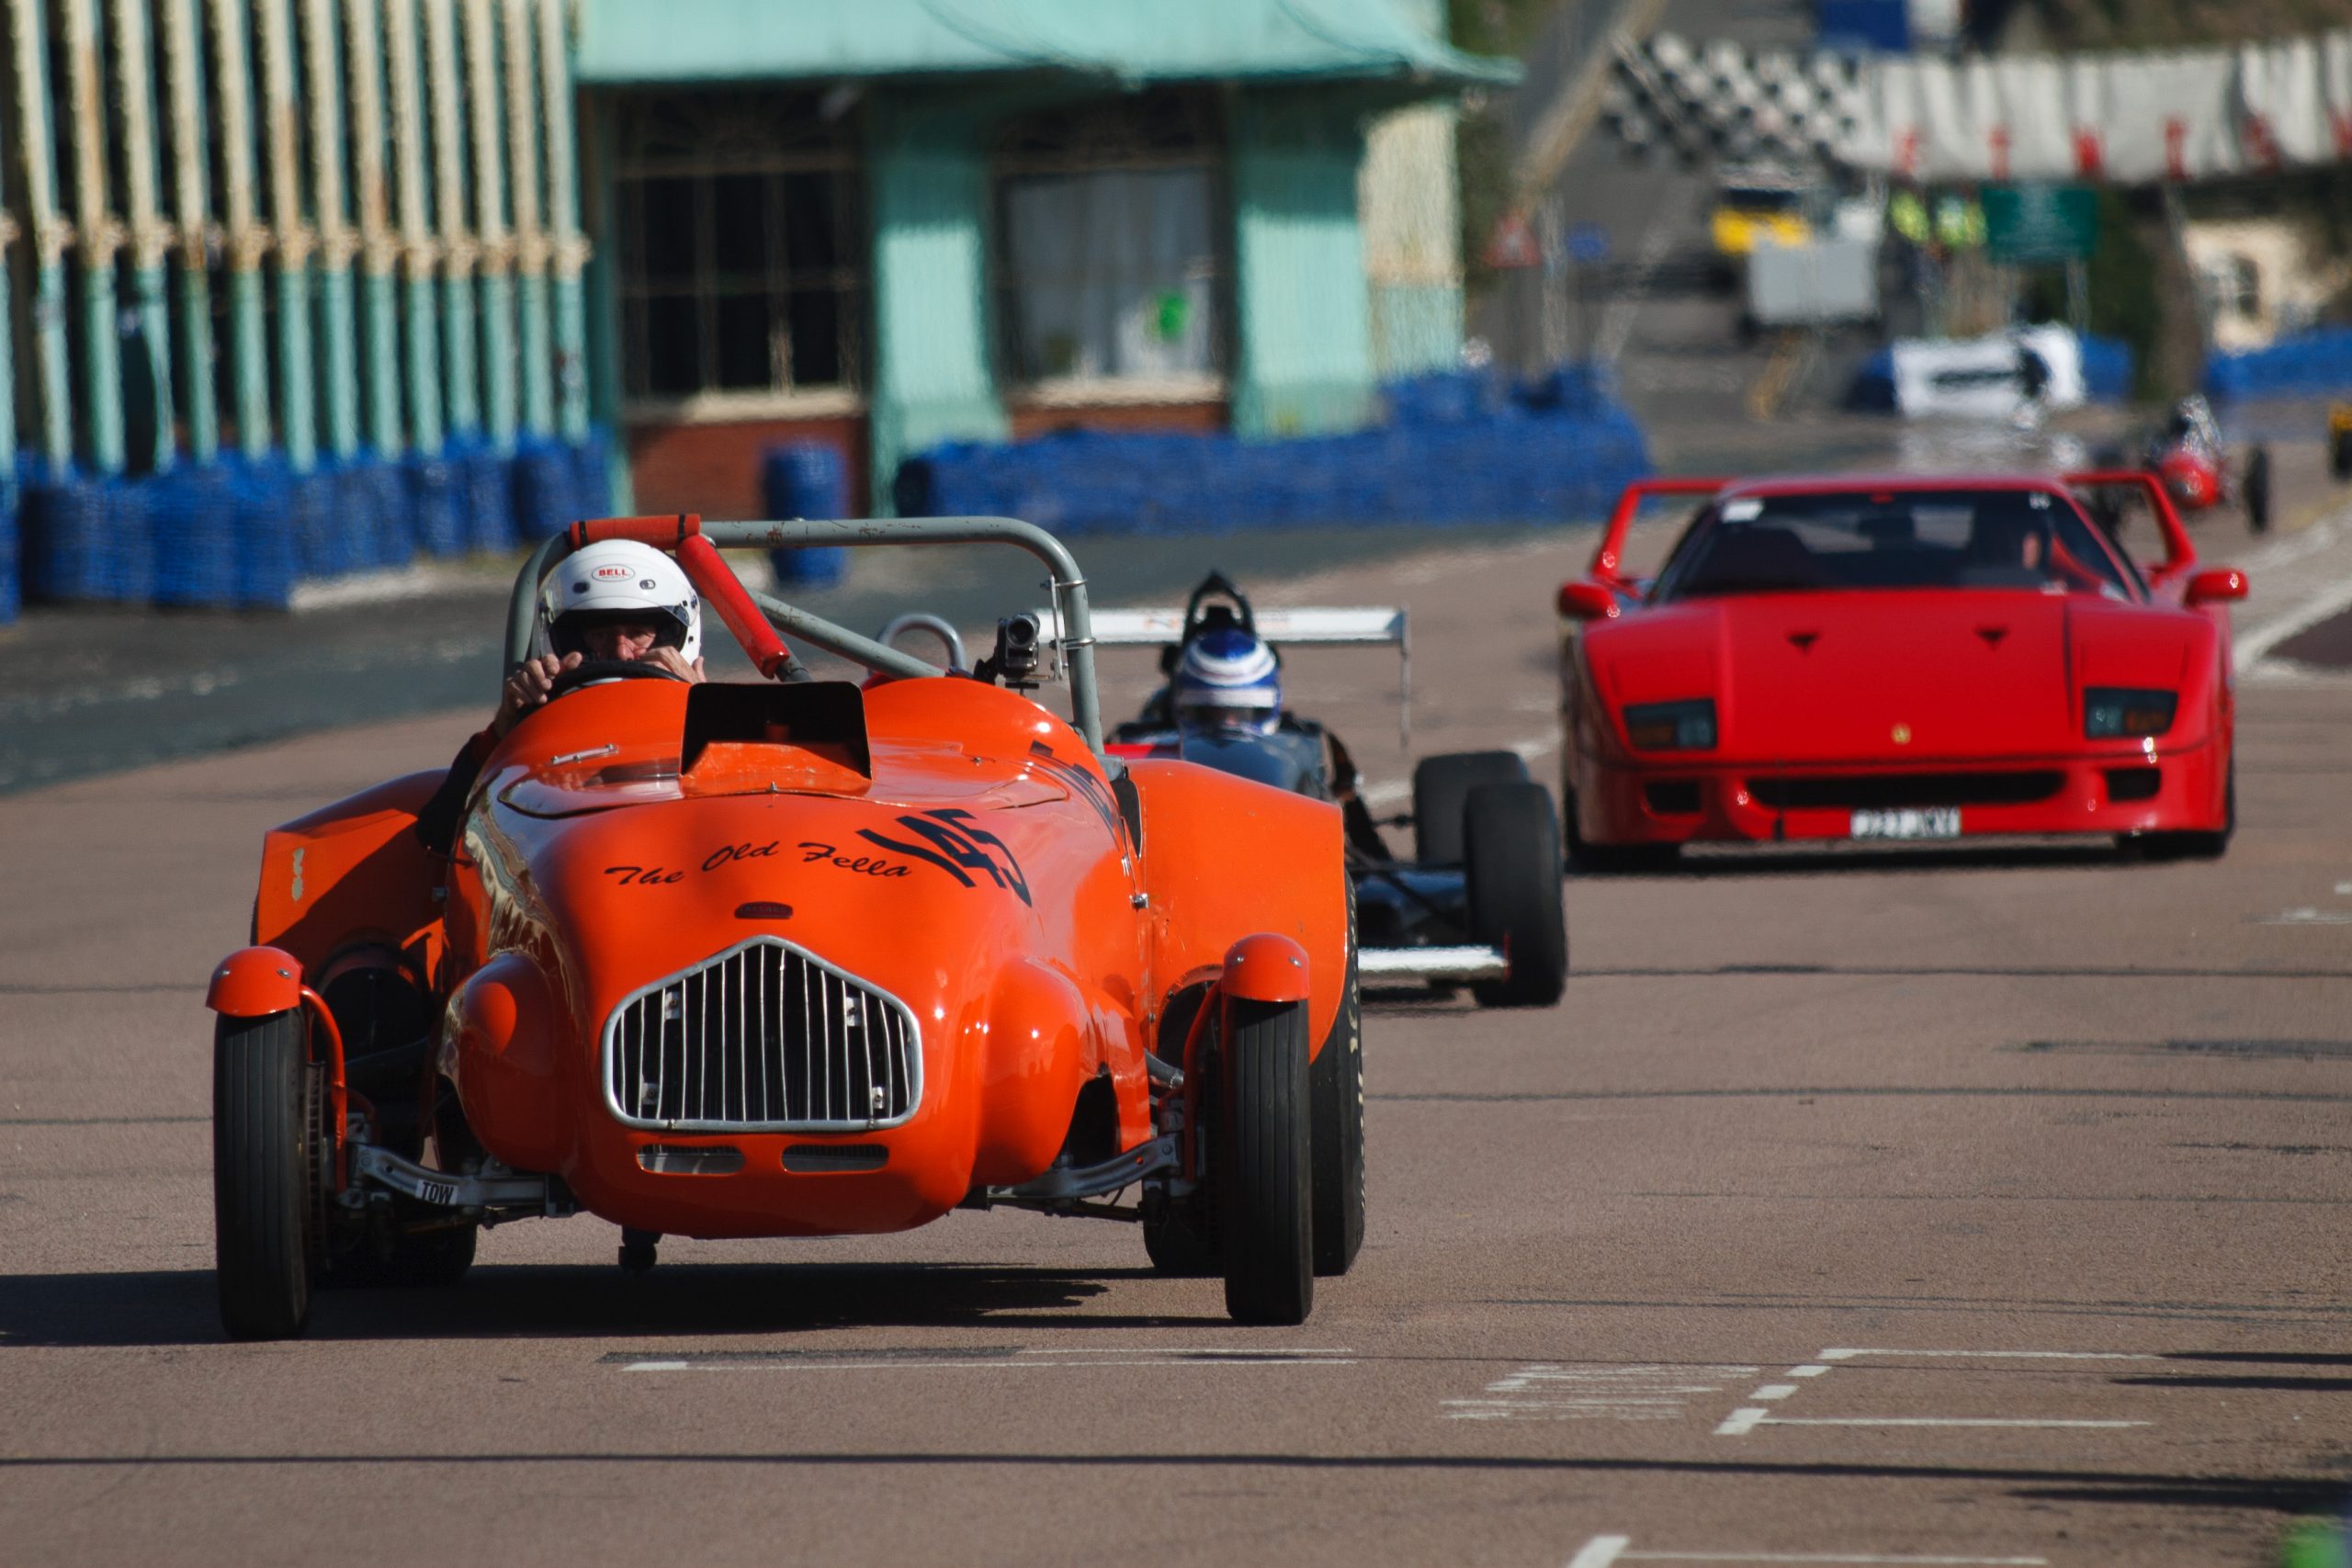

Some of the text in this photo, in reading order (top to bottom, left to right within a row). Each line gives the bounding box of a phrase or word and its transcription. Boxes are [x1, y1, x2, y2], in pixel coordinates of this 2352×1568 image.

[599, 569, 629, 577] BELL
[605, 840, 913, 886] The Old Fella
[855, 808, 1034, 908] 145
[421, 1181, 455, 1205] TOW
